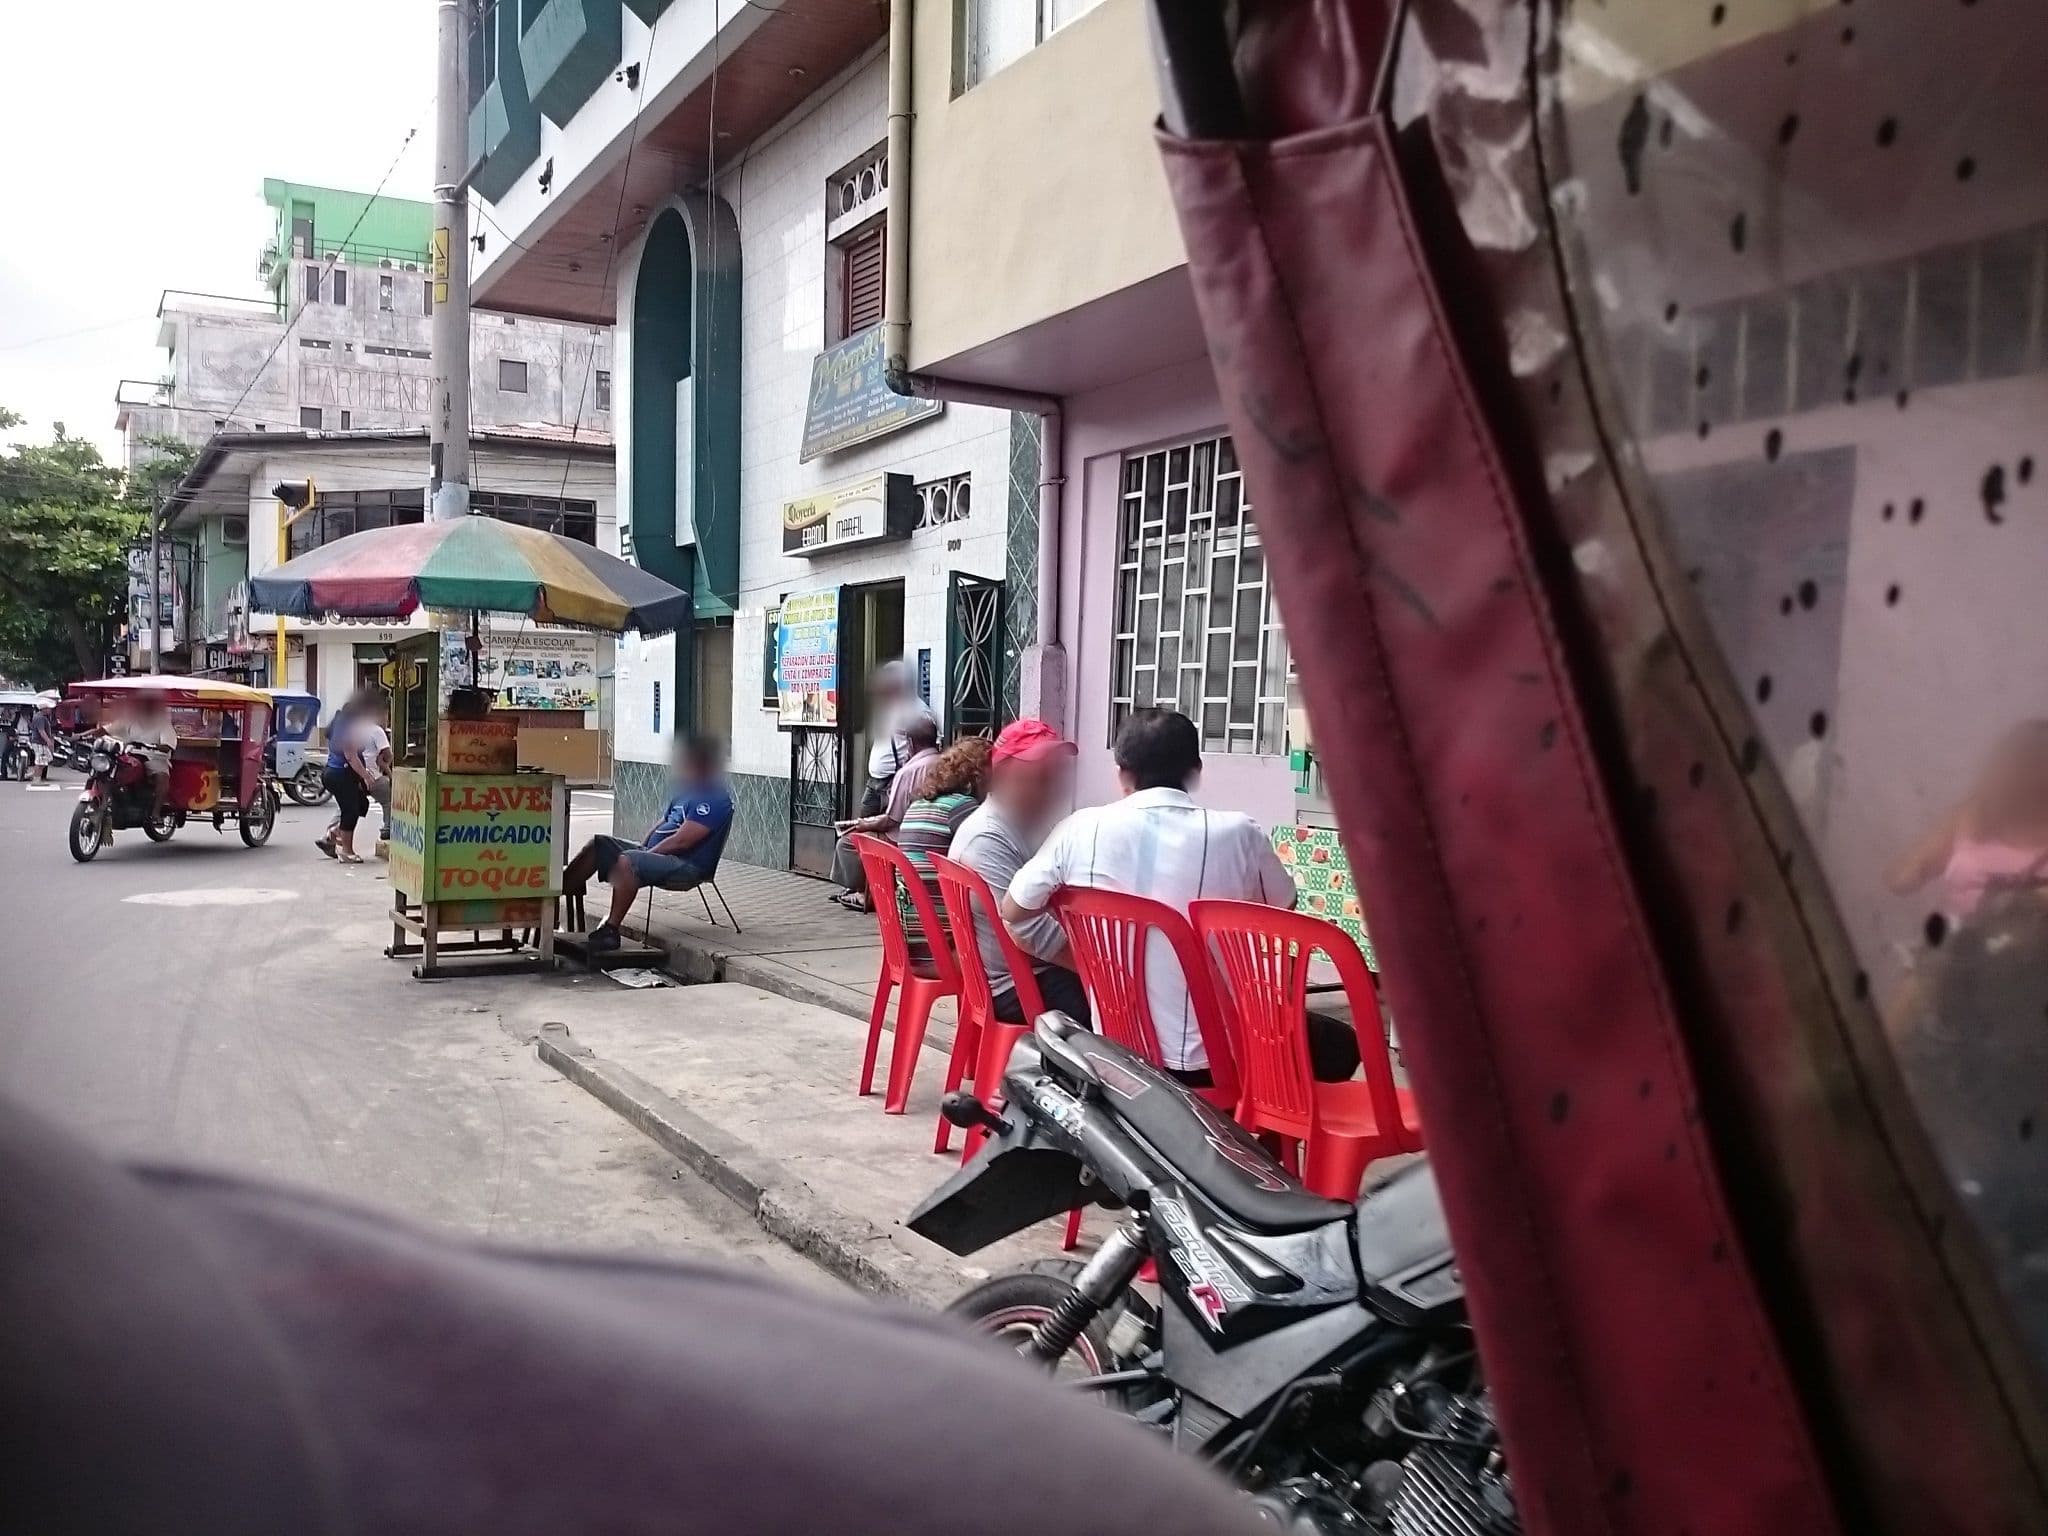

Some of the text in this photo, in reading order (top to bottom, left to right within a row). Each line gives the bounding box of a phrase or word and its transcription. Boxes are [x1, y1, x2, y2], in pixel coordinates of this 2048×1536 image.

[304, 367, 432, 412] PARTHENO
[835, 515, 864, 540] MARFIL
[533, 638, 576, 647] ESCOLAR
[817, 654, 835, 665] JOYAS
[486, 812, 501, 821] Y
[477, 850, 508, 861] AL
[439, 866, 547, 892] TOQUE
